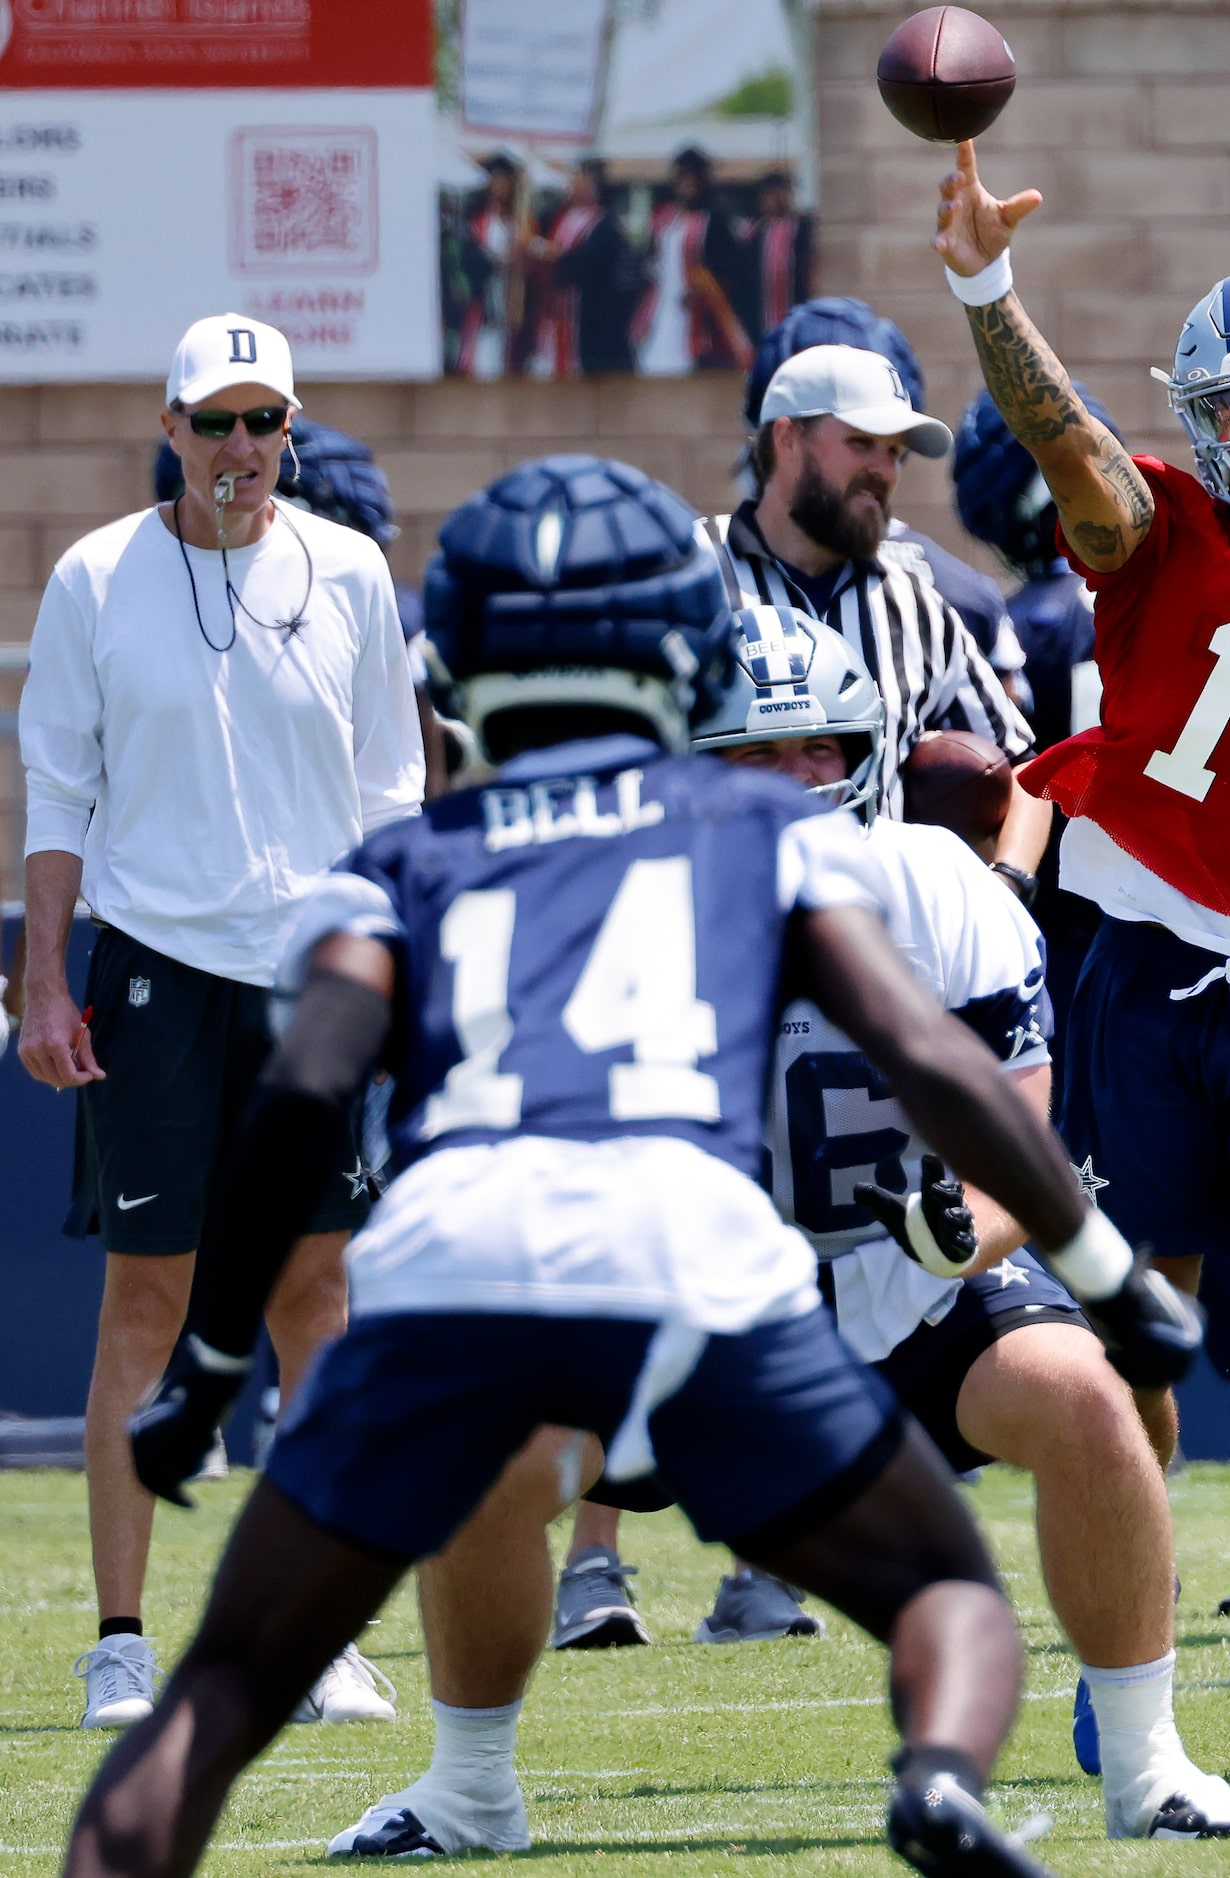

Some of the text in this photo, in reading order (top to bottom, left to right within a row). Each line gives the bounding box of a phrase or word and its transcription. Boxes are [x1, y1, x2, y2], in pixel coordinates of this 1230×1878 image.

[227, 329, 257, 363] D
[759, 700, 811, 714] COWBOYS
[484, 768, 665, 853] BELL
[420, 855, 722, 1142] 14
